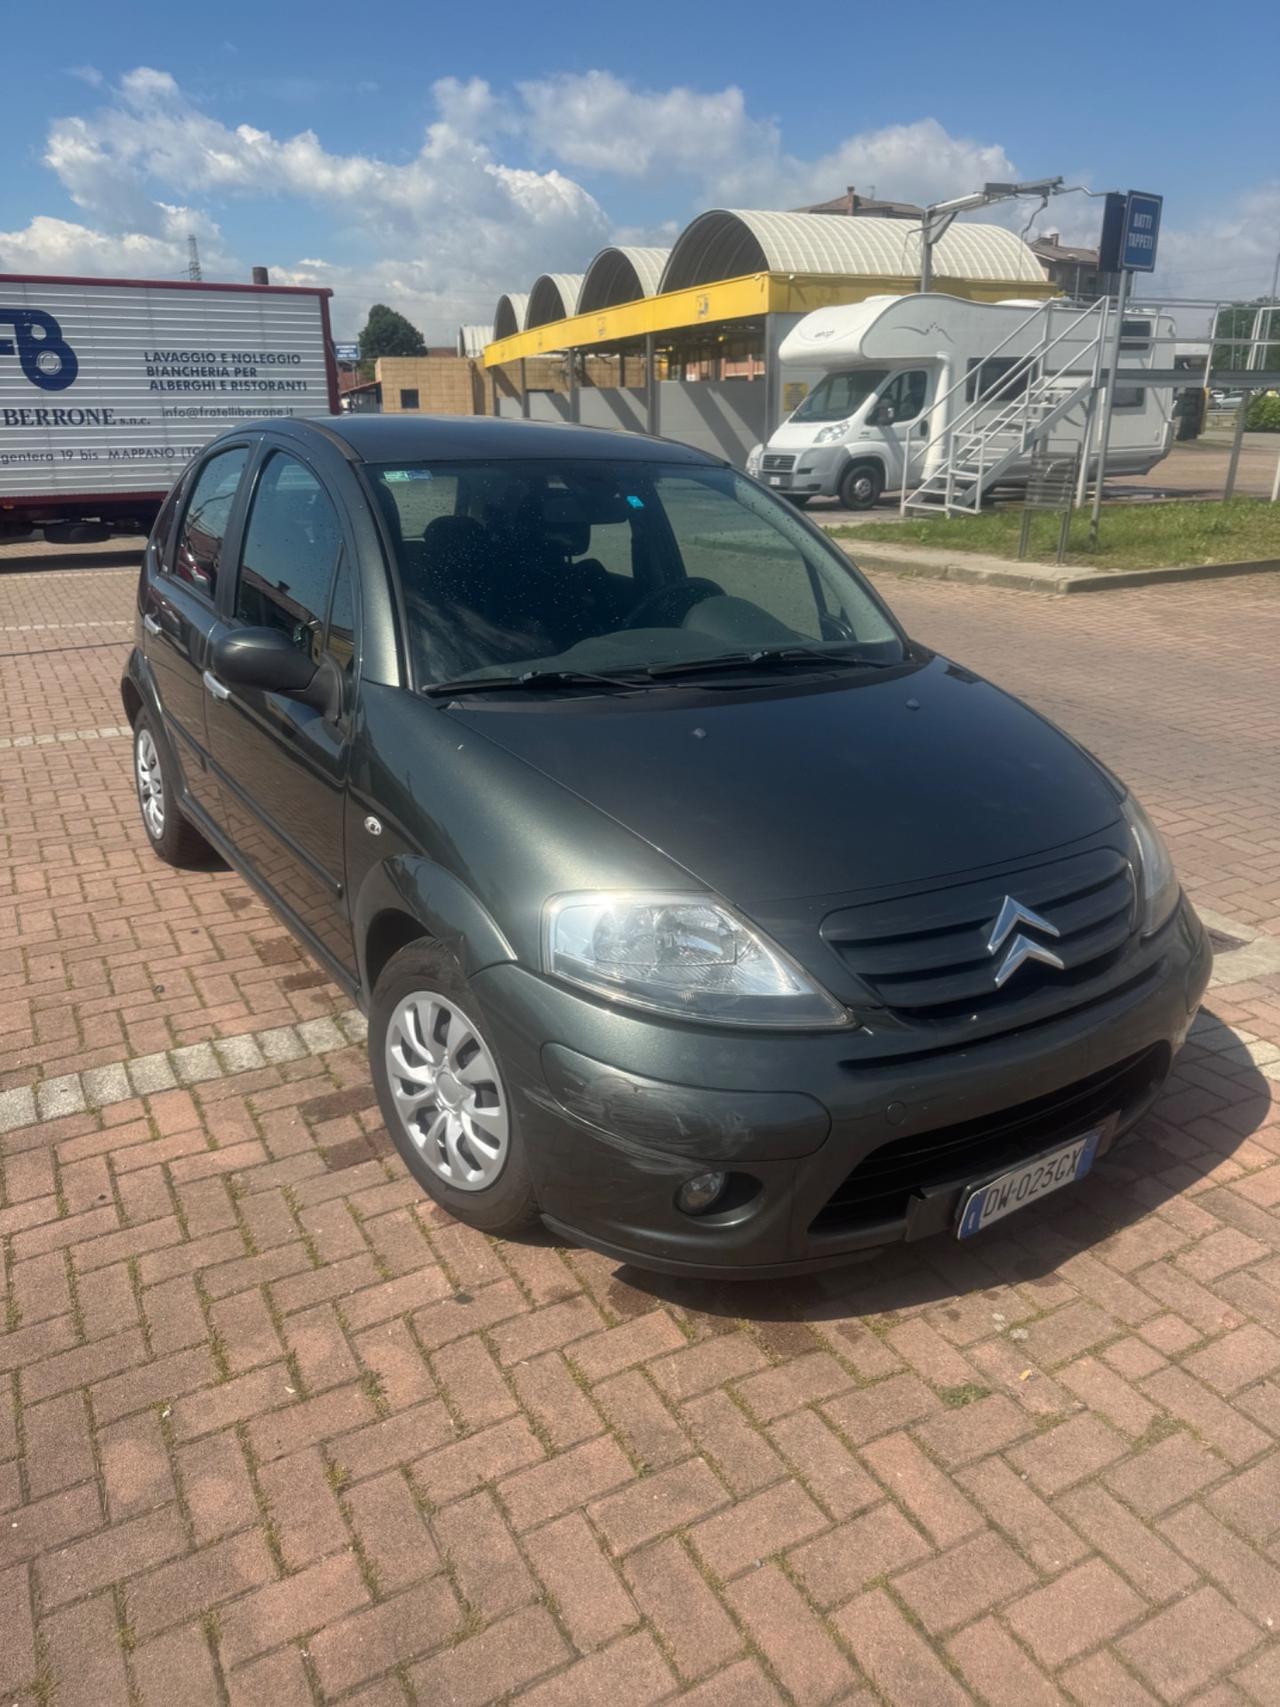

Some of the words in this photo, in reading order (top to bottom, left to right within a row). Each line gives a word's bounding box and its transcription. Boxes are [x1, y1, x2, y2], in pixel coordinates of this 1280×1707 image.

[144, 351, 216, 363] LAVAGGIO
[221, 352, 228, 363] E
[231, 352, 301, 364] NOLEGGIO
[146, 366, 230, 377] BIANCHERIA
[234, 366, 257, 377] PER
[150, 380, 216, 391] ALBERGHI
[220, 380, 227, 391] E
[231, 380, 307, 391] RISTORANTI
[3, 408, 116, 426] BERRONE
[119, 417, 151, 425] s.n.c.
[161, 406, 294, 419] info@fratelliberrone.it
[60, 449, 74, 460] 19
[80, 448, 98, 461] bis
[108, 447, 176, 460] MAPPANO
